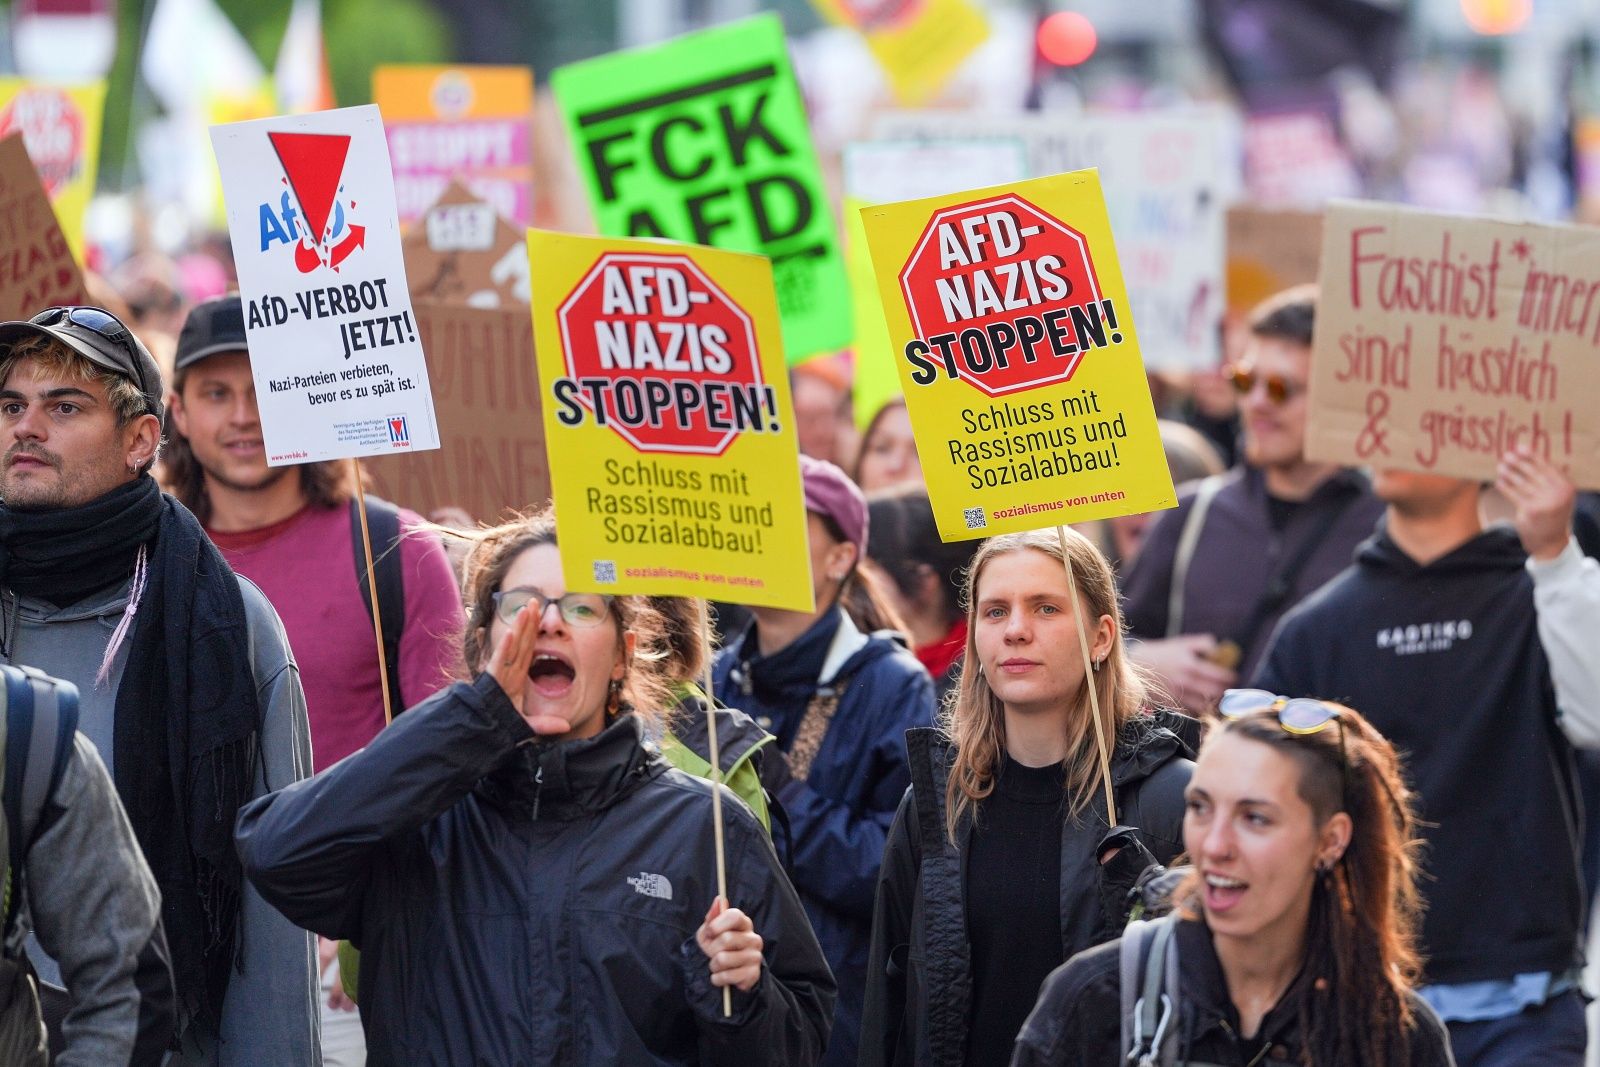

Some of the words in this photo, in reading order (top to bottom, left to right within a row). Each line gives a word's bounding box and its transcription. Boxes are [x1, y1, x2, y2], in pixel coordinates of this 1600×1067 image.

[586, 94, 792, 201] FCK
[937, 209, 1043, 271] AFD-
[248, 277, 389, 330] AfD-VERBOT
[602, 264, 710, 318] AFD-
[934, 253, 1071, 324] NAZIS
[339, 310, 416, 361] JETZT!
[594, 320, 733, 375] NAZIS
[904, 298, 1123, 386] STOPPEN!
[269, 370, 337, 393] Nazi-Parteien
[340, 363, 393, 381] verbieten,
[1335, 324, 1412, 390] sind
[1436, 323, 1559, 402] hässlich
[308, 391, 337, 405] bevor
[340, 389, 353, 400] es
[355, 386, 368, 398] zu
[371, 379, 395, 397] spät
[397, 377, 416, 391] ist.
[553, 376, 781, 434] STOPPEN!
[961, 402, 1055, 434] Schluss
[1061, 389, 1101, 417] mit
[948, 425, 1077, 465] Rassismus
[1083, 412, 1127, 442] und
[1355, 389, 1391, 458] &
[604, 458, 702, 491] Schluss
[709, 468, 749, 496] mit
[967, 442, 1121, 490] Sozialabbau!
[586, 486, 722, 522] Rassismus
[728, 501, 774, 528] und
[993, 500, 1064, 519] sozialismus
[1065, 495, 1089, 508] von
[1090, 490, 1126, 504] unten
[603, 516, 763, 555] Sozialabbau!
[625, 567, 700, 581] sozialismus
[704, 574, 726, 584] von
[727, 577, 764, 588] unten
